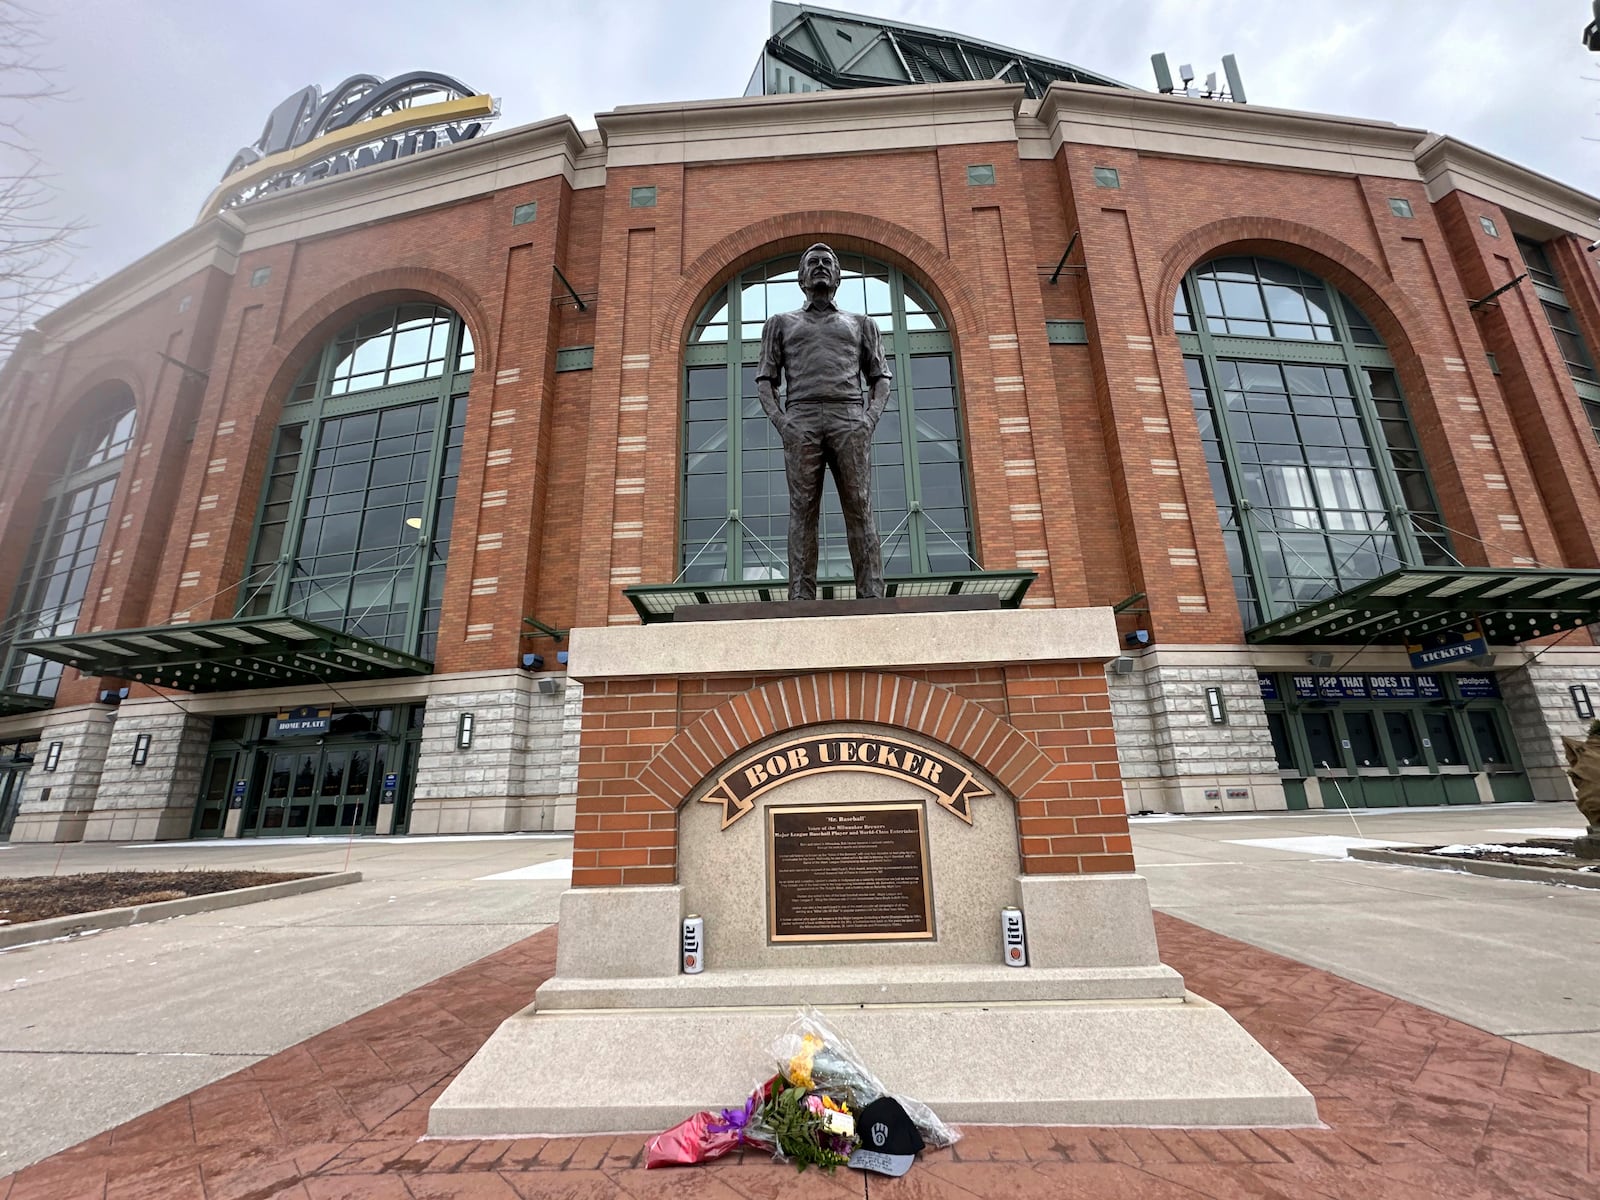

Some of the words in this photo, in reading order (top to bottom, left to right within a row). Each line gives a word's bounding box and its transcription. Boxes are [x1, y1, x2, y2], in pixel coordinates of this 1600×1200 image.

[1420, 644, 1473, 662] TICKETS
[1293, 677, 1315, 688] THE
[1339, 677, 1364, 688] THAT
[1370, 677, 1398, 688] DOES
[1400, 677, 1411, 688] IT
[1418, 677, 1435, 688] ALL
[1463, 678, 1490, 686] Ballpark
[279, 722, 300, 730] HOME
[301, 720, 326, 729] PLATE
[743, 747, 810, 789] BOB
[818, 742, 944, 784] UECKER
[684, 925, 699, 953] Lite
[1007, 917, 1023, 946] Lite
